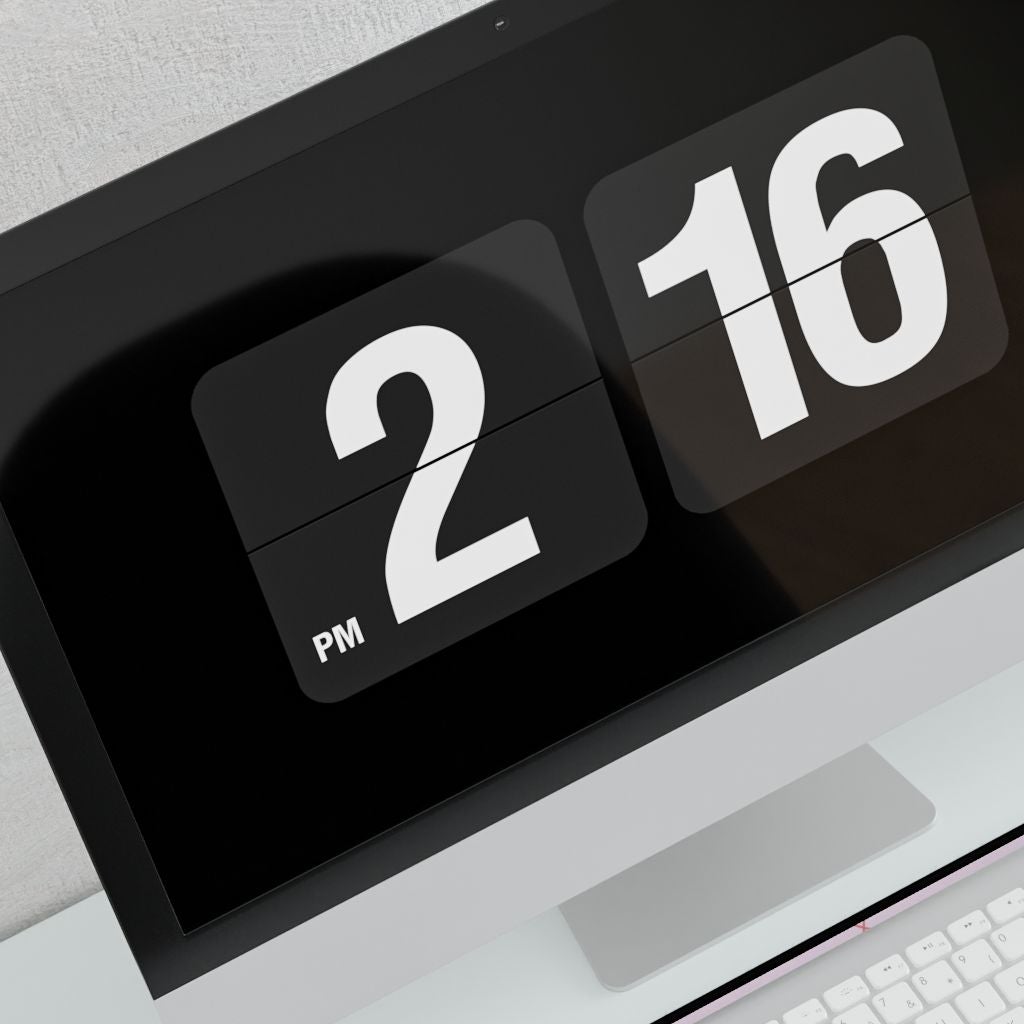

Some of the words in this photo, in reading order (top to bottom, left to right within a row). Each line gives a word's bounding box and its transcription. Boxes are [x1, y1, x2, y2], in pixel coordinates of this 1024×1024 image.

[325, 325, 541, 624] 2
[638, 108, 948, 440] 16
[312, 616, 365, 663] PM
[878, 998, 886, 1008] 7
[918, 976, 928, 986] 8
[958, 955, 967, 964] 9
